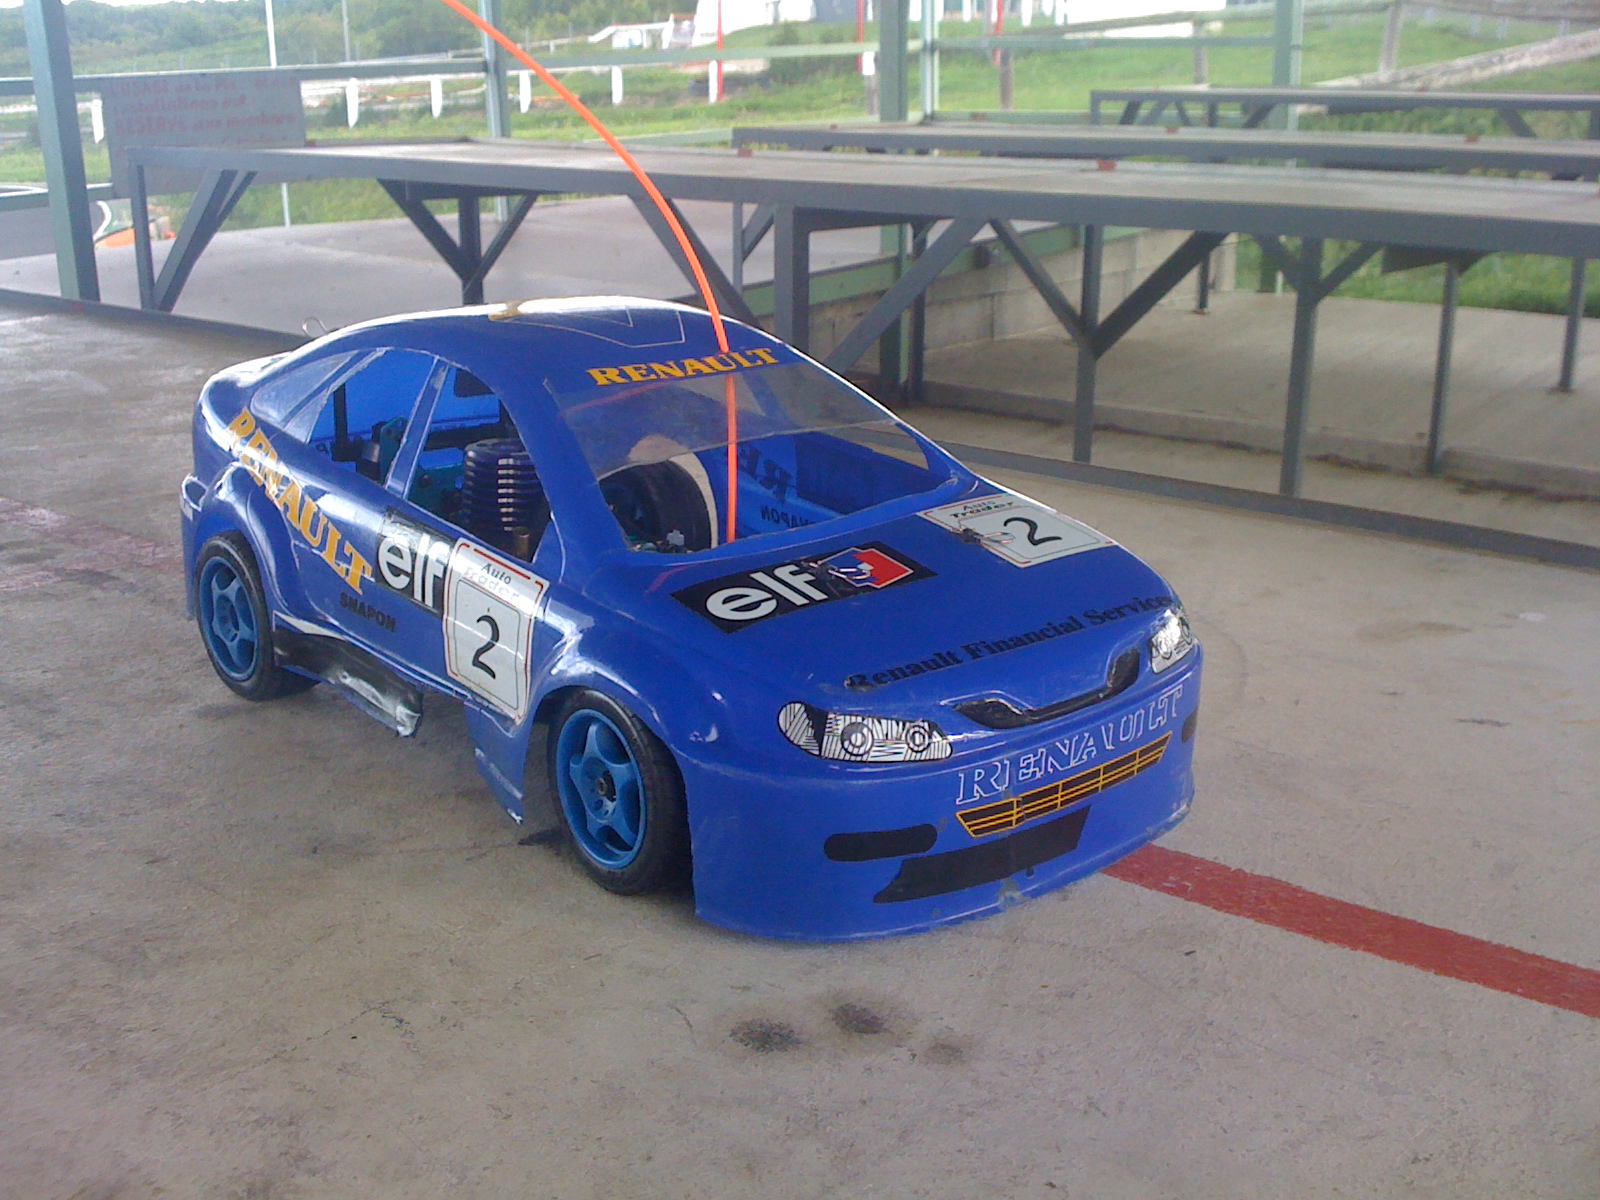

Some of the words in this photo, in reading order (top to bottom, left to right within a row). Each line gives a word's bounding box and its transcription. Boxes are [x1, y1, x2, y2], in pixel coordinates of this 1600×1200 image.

[586, 347, 780, 386] RENAULT
[228, 405, 374, 596] RENAULT
[950, 501, 1015, 519] Trader
[1003, 516, 1063, 547] 2
[378, 532, 451, 609] elf
[480, 562, 512, 586] Auto
[705, 563, 829, 622] elf
[340, 592, 397, 633] SNAPON
[472, 614, 500, 681] 2
[847, 651, 965, 691] Renault
[960, 615, 1087, 661] Financial
[955, 684, 1184, 805] RENAULT
